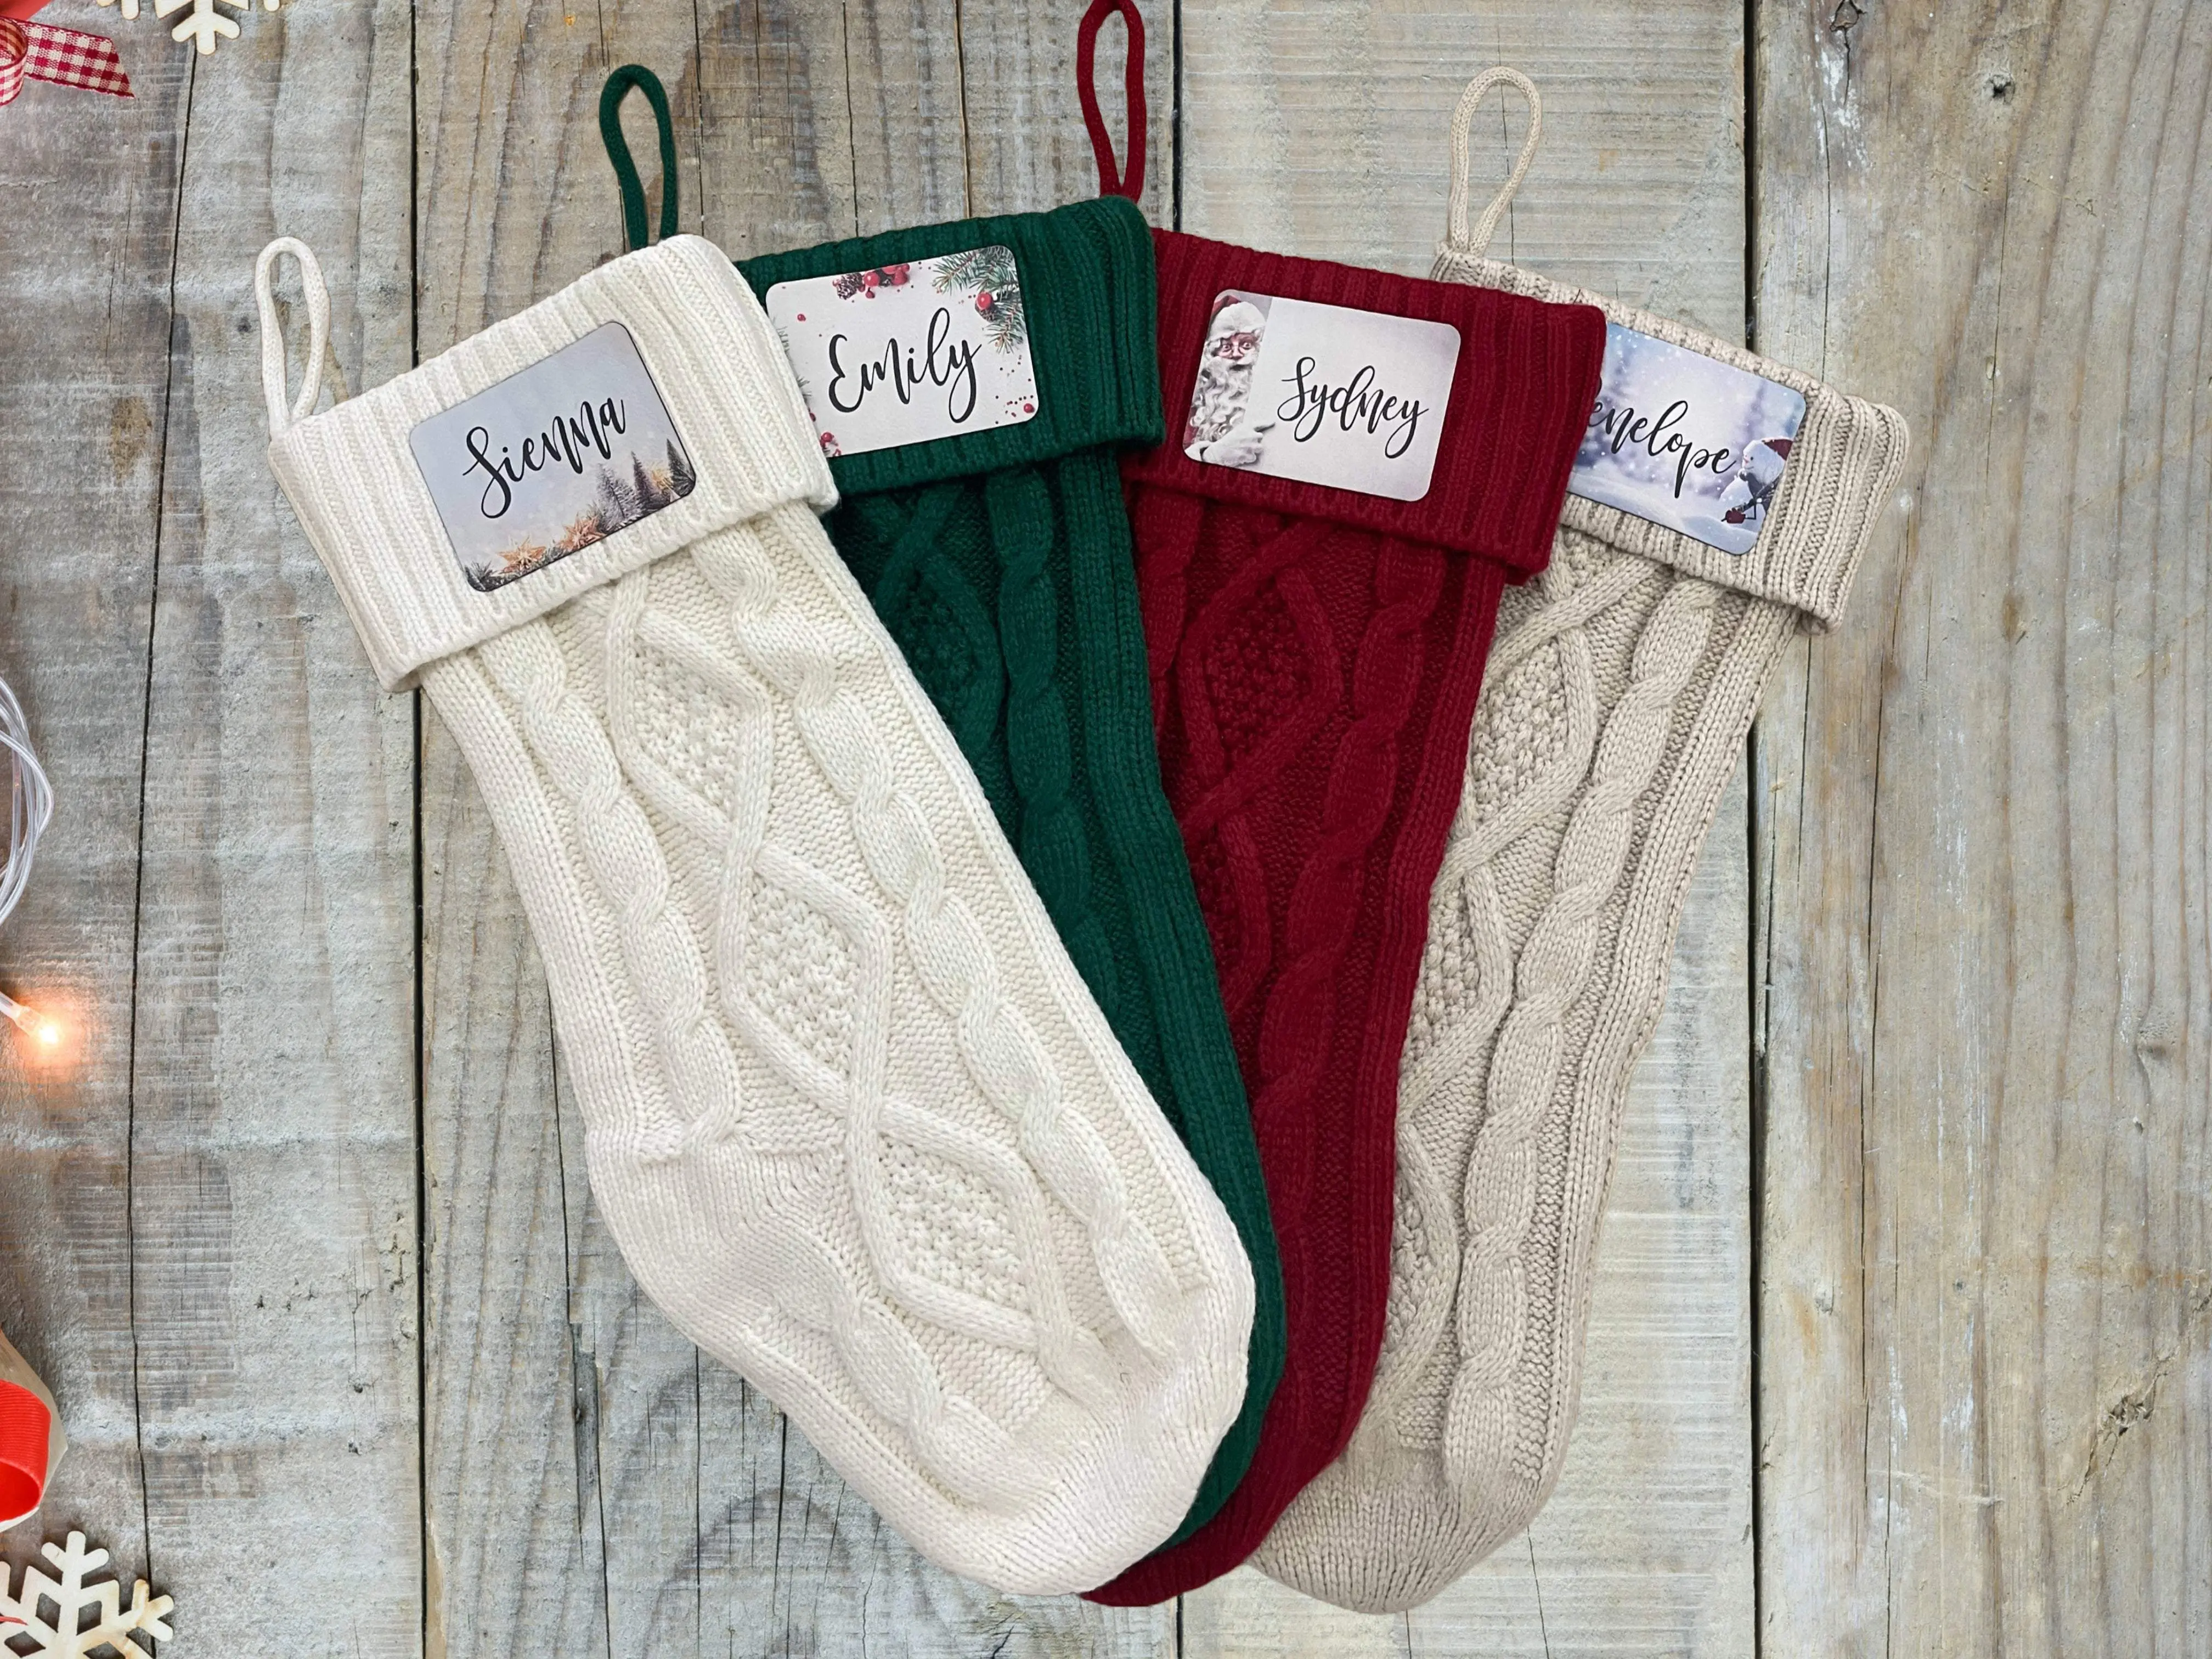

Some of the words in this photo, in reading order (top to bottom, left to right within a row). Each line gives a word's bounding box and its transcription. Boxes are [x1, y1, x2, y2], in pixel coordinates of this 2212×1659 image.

[828, 307, 982, 424] Emily
[1277, 357, 1429, 459] Sydney
[462, 397, 626, 519] Sienna
[1587, 376, 1736, 499] enelope
